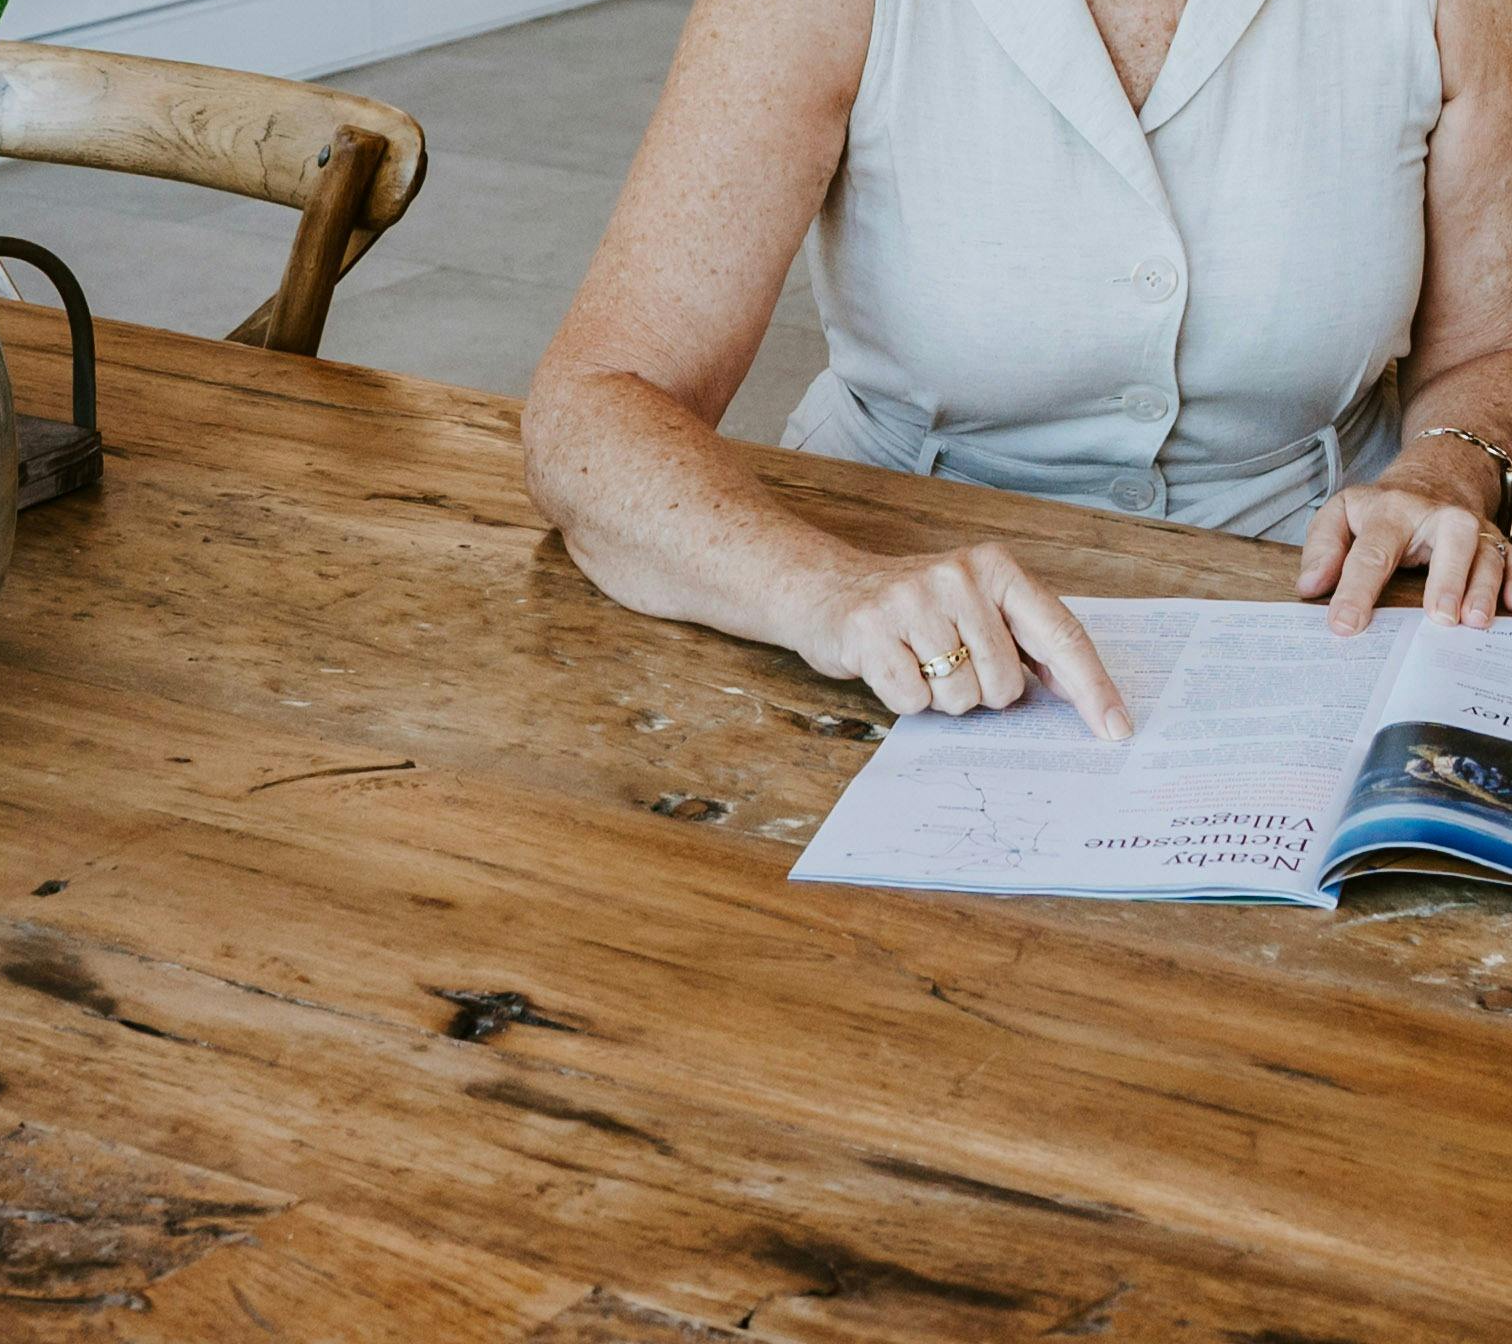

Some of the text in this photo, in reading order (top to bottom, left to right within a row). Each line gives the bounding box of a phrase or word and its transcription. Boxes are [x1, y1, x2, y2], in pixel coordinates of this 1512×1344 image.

[1169, 812, 1317, 833] Villages
[1083, 833, 1313, 854] Picturesque
[1161, 851, 1306, 873] Nearby
